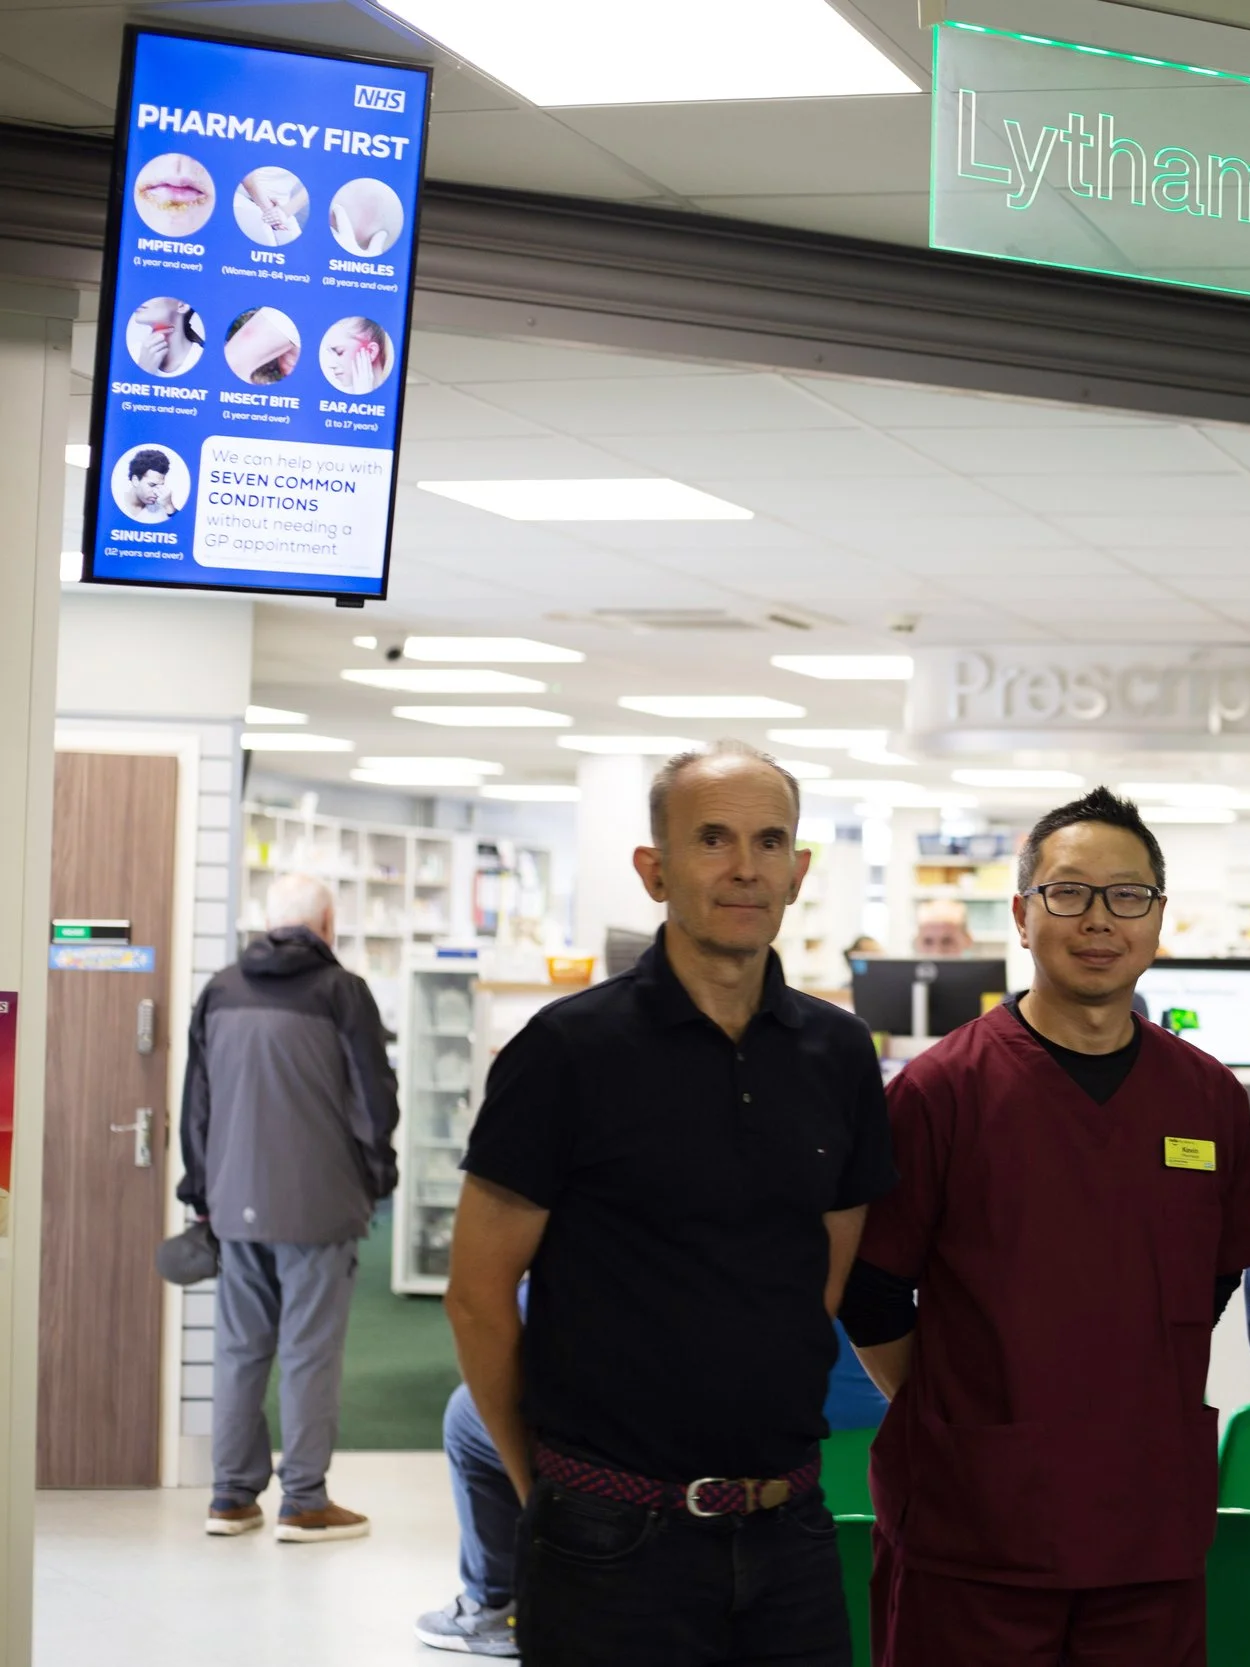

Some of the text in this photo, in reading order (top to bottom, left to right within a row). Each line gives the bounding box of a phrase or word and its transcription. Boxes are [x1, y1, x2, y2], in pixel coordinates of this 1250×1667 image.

[358, 88, 402, 109] NHS
[137, 103, 409, 160] PHARMACY FIRST
[138, 238, 205, 256] IMPETIGO
[142, 259, 161, 267] year
[181, 263, 203, 272] over)
[251, 251, 285, 264] UTI'S
[222, 265, 310, 283] (Women 16-64 years)
[329, 259, 394, 276] SHINGLES
[323, 276, 398, 292] (18 years and over)
[112, 382, 208, 400] SORE THROAT
[220, 391, 300, 409] INSECT BITE
[132, 404, 156, 412] years
[158, 405, 174, 413] and
[176, 407, 198, 416] over)
[320, 400, 386, 416] EAR ACHE
[230, 412, 250, 420] year
[251, 413, 267, 422] and
[269, 415, 290, 424] over)
[334, 420, 342, 428] to
[353, 422, 378, 432] years)
[212, 449, 382, 475] We can help you with
[210, 470, 356, 494] SEVEN COMMON
[208, 491, 318, 512] CONDITIONS
[206, 514, 352, 539] without needing a
[110, 529, 178, 544] SINUSITIS
[205, 533, 337, 556] GP appointment
[119, 549, 142, 558] years
[162, 552, 184, 560] over)
